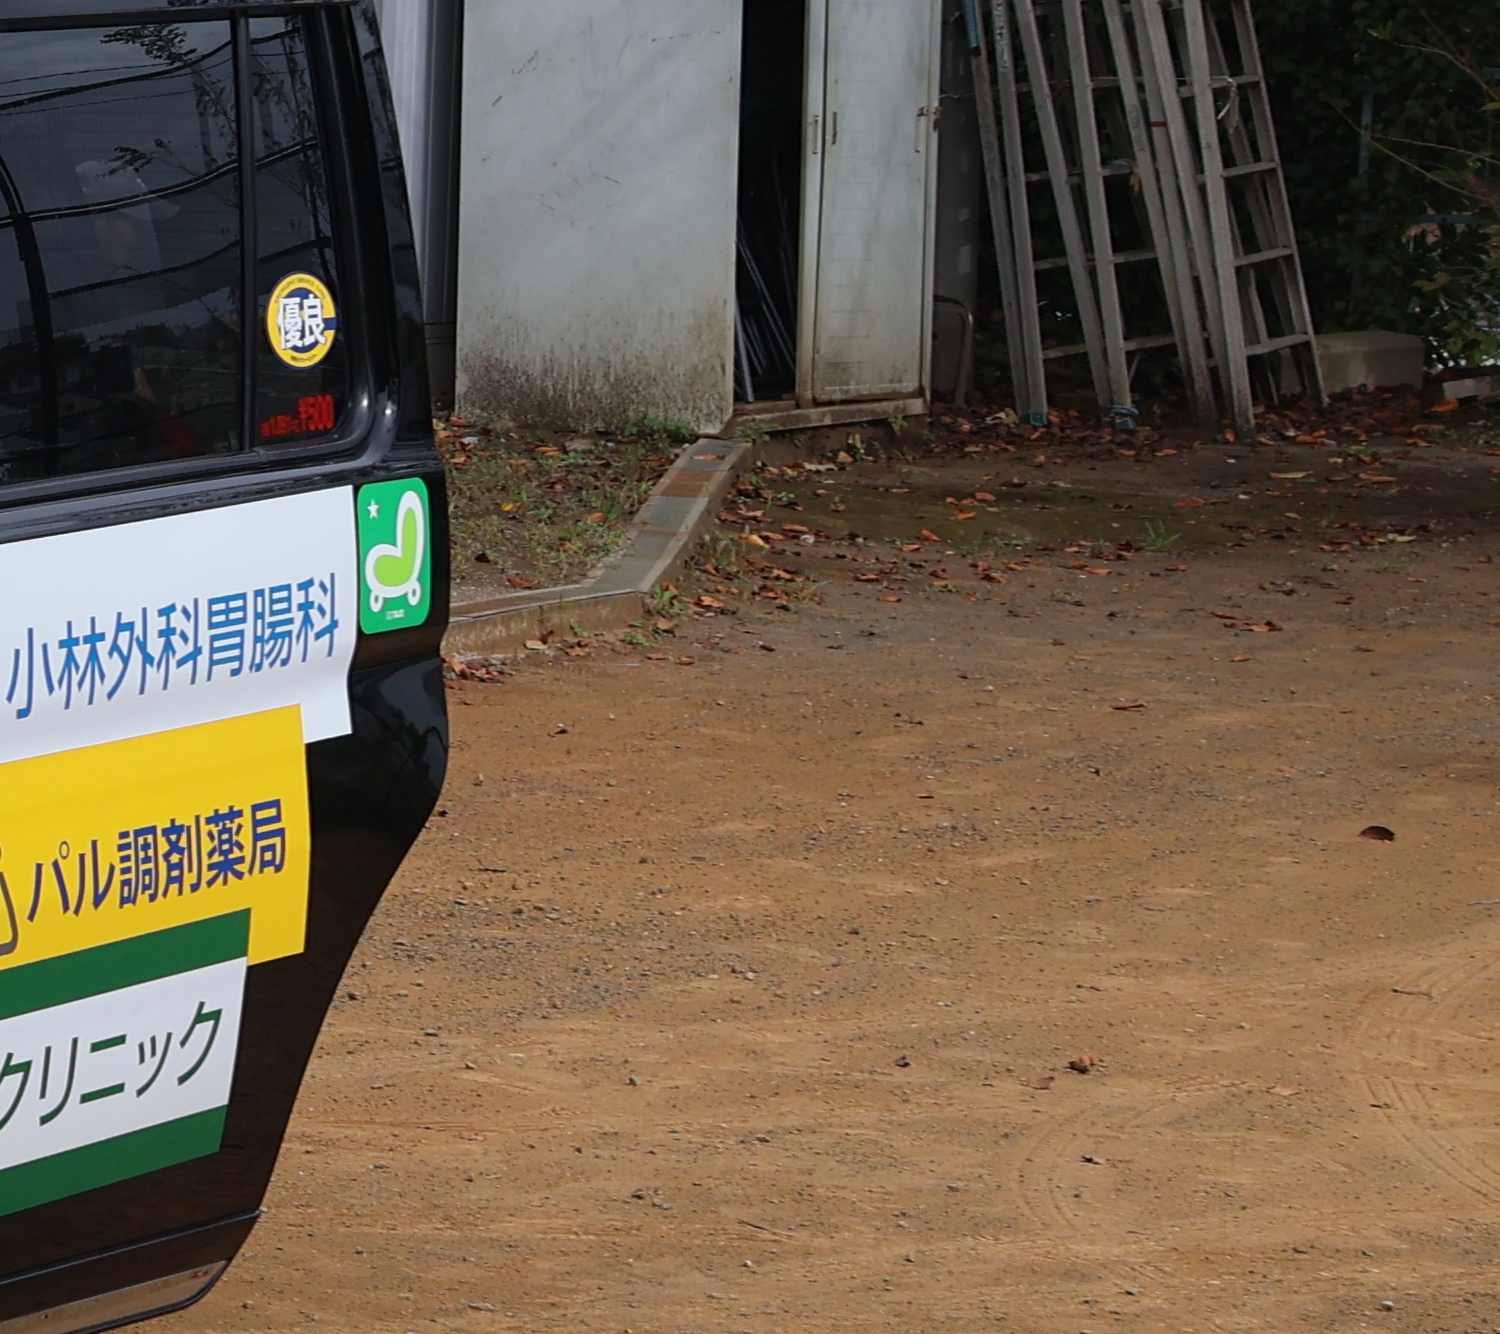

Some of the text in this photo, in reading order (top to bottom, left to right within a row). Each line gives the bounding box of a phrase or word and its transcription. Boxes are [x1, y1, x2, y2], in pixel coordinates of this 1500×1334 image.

[277, 293, 326, 350] 優良
[7, 572, 339, 720] 小林外科胃腸科
[26, 797, 286, 924] パル調剤薬局
